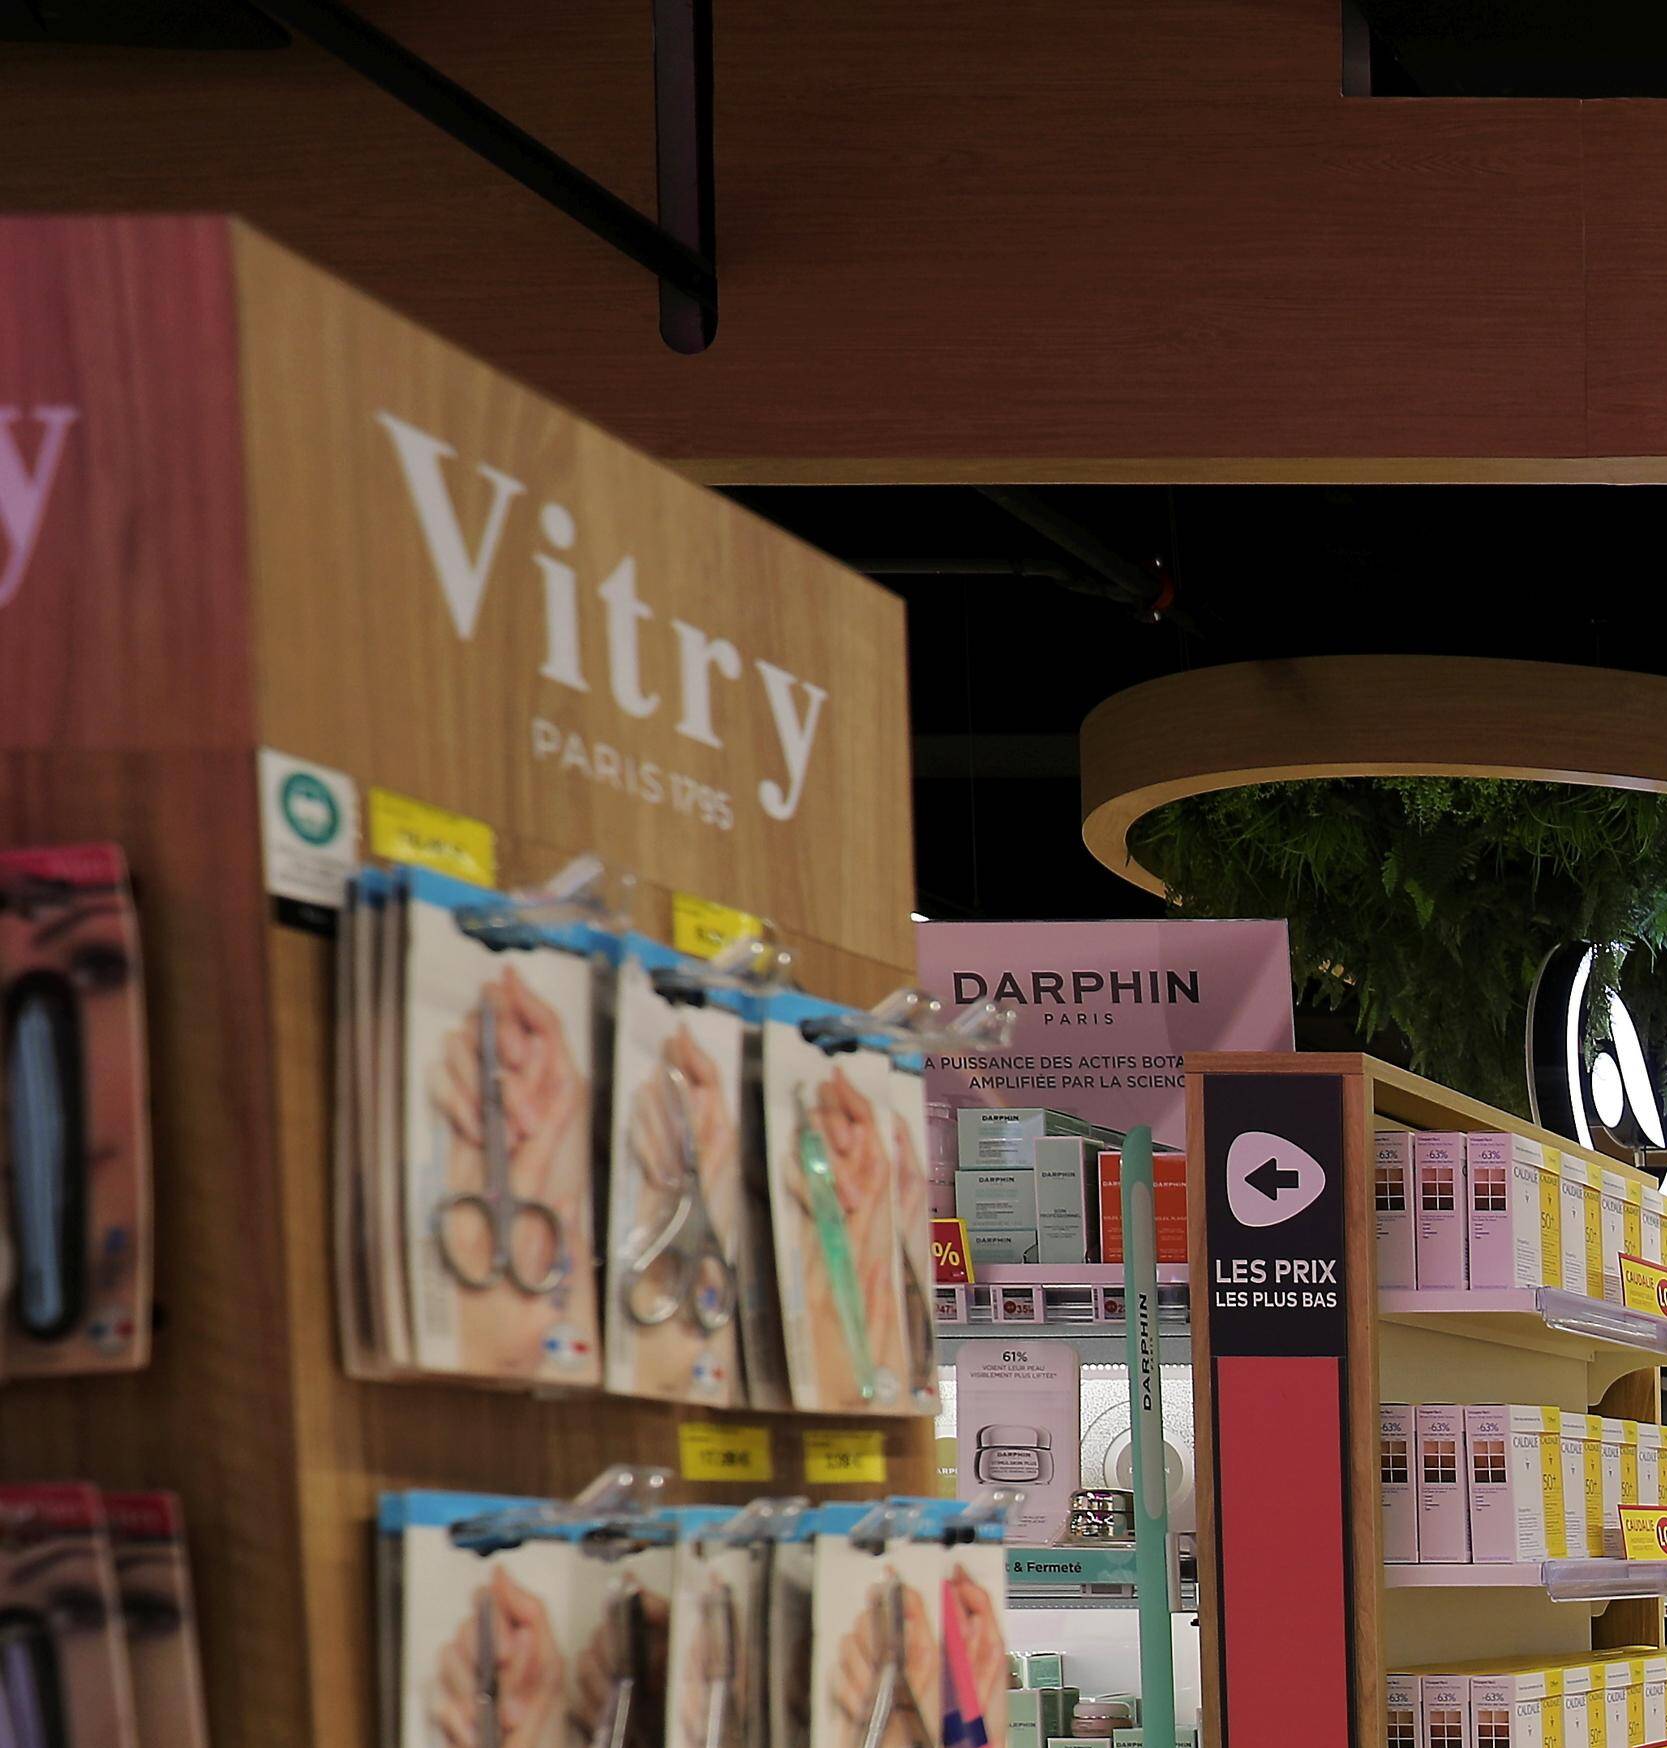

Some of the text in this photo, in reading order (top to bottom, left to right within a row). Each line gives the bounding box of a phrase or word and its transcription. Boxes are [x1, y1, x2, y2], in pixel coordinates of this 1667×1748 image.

[377, 411, 829, 821] Vitry
[531, 717, 735, 832] PARIS 1795
[953, 971, 1200, 1005] DARPHIN
[1044, 1013, 1115, 1025] PARIS
[941, 1056, 1034, 1070] PUISSANCE
[1041, 1056, 1073, 1069] DES
[1078, 1056, 1137, 1069] ACTIFS
[969, 1073, 1057, 1089] AMPLIFIÉE
[1062, 1076, 1095, 1088] PAR
[1100, 1076, 1121, 1088] LA
[982, 1114, 1019, 1122] DARPHIN
[1215, 1259, 1337, 1284] LES PRIX
[1625, 1270, 1655, 1290] CAUDALIE
[1215, 1292, 1337, 1308] LES PLUS BAS
[1002, 1351, 1028, 1363] 61%
[1138, 1292, 1152, 1411] DARPHIN
[1428, 1423, 1450, 1432] -63%
[1477, 1423, 1499, 1432] -63%
[1626, 1519, 1655, 1532] CAUDALIE
[1014, 1561, 1082, 1573] & Fermeté
